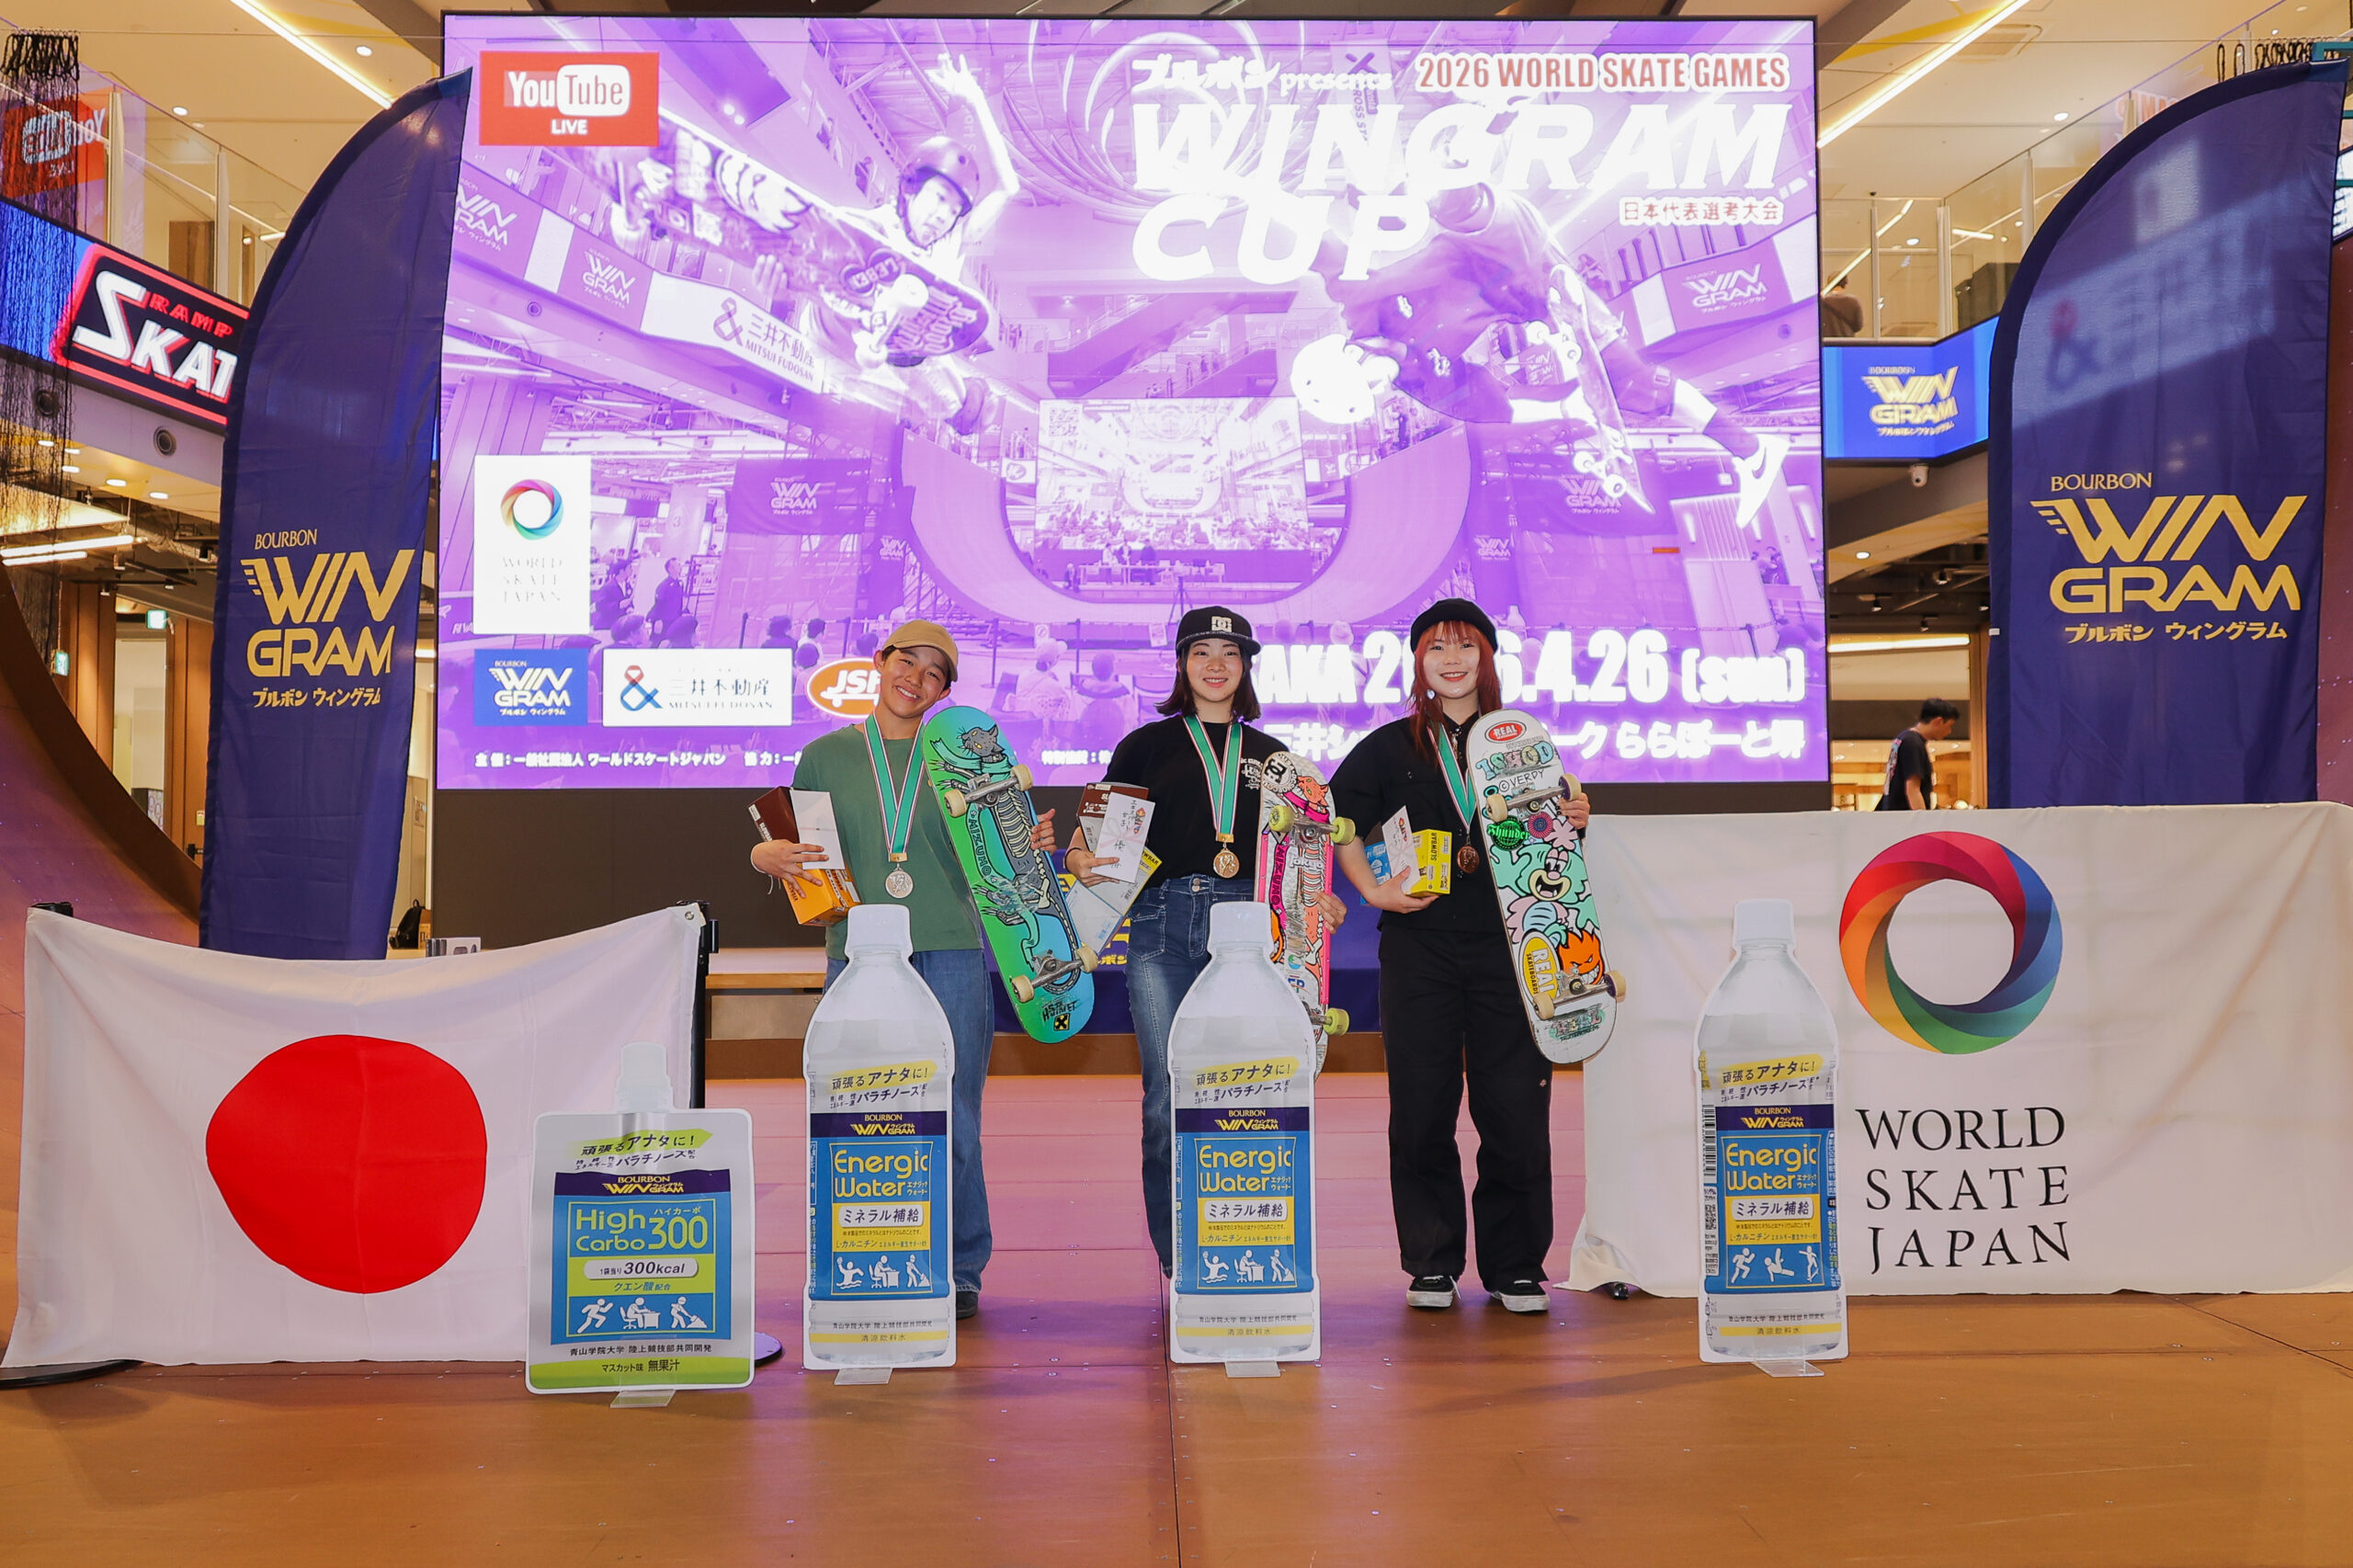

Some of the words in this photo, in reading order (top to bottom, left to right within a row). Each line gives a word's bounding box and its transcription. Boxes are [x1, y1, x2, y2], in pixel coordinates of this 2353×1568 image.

[1279, 72, 1393, 97] presents
[1419, 57, 1490, 88] 2026
[1498, 57, 1595, 88] WORLD
[1603, 57, 1687, 88] SKATE
[1694, 57, 1786, 88] GAMES
[508, 71, 623, 108] YouTube
[1353, 88, 1366, 119] ROSS
[551, 119, 588, 134] LIVE
[1131, 103, 1793, 194] WINGRAM
[1624, 200, 1780, 222] 日本代表選考大会
[454, 206, 508, 246] RAM
[1131, 194, 1430, 284] CUP
[584, 250, 636, 290] WIN
[1682, 264, 1762, 294] WIN
[582, 270, 631, 304] GRAM
[1692, 282, 1768, 307] GRAM
[1861, 366, 1959, 403] WIN
[1869, 396, 1960, 426] GRAM
[769, 482, 822, 497] WIN
[2050, 472, 2153, 492] BOURBON
[770, 497, 817, 509] GRAM
[254, 528, 318, 550] BOURBON
[2029, 494, 2308, 564] WIN
[240, 549, 415, 625] WIN
[2050, 564, 2302, 613] GRAM
[2064, 622, 2154, 644] ブルボン
[2165, 620, 2288, 641] ウィングラム
[246, 626, 395, 677] GRAM
[488, 667, 574, 690] WIN
[1252, 644, 1358, 703] AKA
[252, 687, 308, 708] ブルボン
[313, 687, 381, 707] ウィングラム
[494, 690, 572, 707] GRAM
[1493, 724, 1518, 738] REAL
[587, 751, 726, 767] ワールドスケートジャパン
[968, 818, 992, 876] MIZUHO
[1270, 844, 1288, 906] MIZUHO
[832, 1067, 928, 1091] 頑張るアナタに!
[1197, 1063, 1290, 1085] 頑張るアナタに!
[857, 1086, 919, 1103] パラチノース
[1221, 1082, 1282, 1098] パラチノース
[1755, 1107, 1791, 1115] BOURBON
[1855, 1107, 2064, 1151] WORLD
[581, 1135, 695, 1155] 頑張るアナタに!
[1726, 1142, 1817, 1172] Energic
[616, 1150, 687, 1167] パラチノース
[834, 1149, 929, 1179] Energic
[1199, 1144, 1292, 1175] Energic
[835, 1177, 907, 1198] Water
[1199, 1172, 1271, 1192] Water
[1726, 1170, 1795, 1190] Water
[1866, 1166, 2069, 1210] SKATE
[654, 1206, 702, 1215] ハイカーボ
[844, 1205, 919, 1223] ミネラル補給
[1209, 1203, 1283, 1218] ミネラル補給
[1736, 1200, 1810, 1217] ミネラル補給
[575, 1208, 644, 1234] High
[648, 1216, 709, 1250] 300
[575, 1235, 645, 1252] Carbo
[1868, 1221, 2070, 1275] JAPAN
[623, 1261, 685, 1275] 300kcal
[570, 1346, 625, 1356] 青山学院大学
[629, 1344, 712, 1355] 陸上競技部共同開発
[601, 1363, 643, 1373] マスカット味
[648, 1359, 680, 1372] 無果汁
